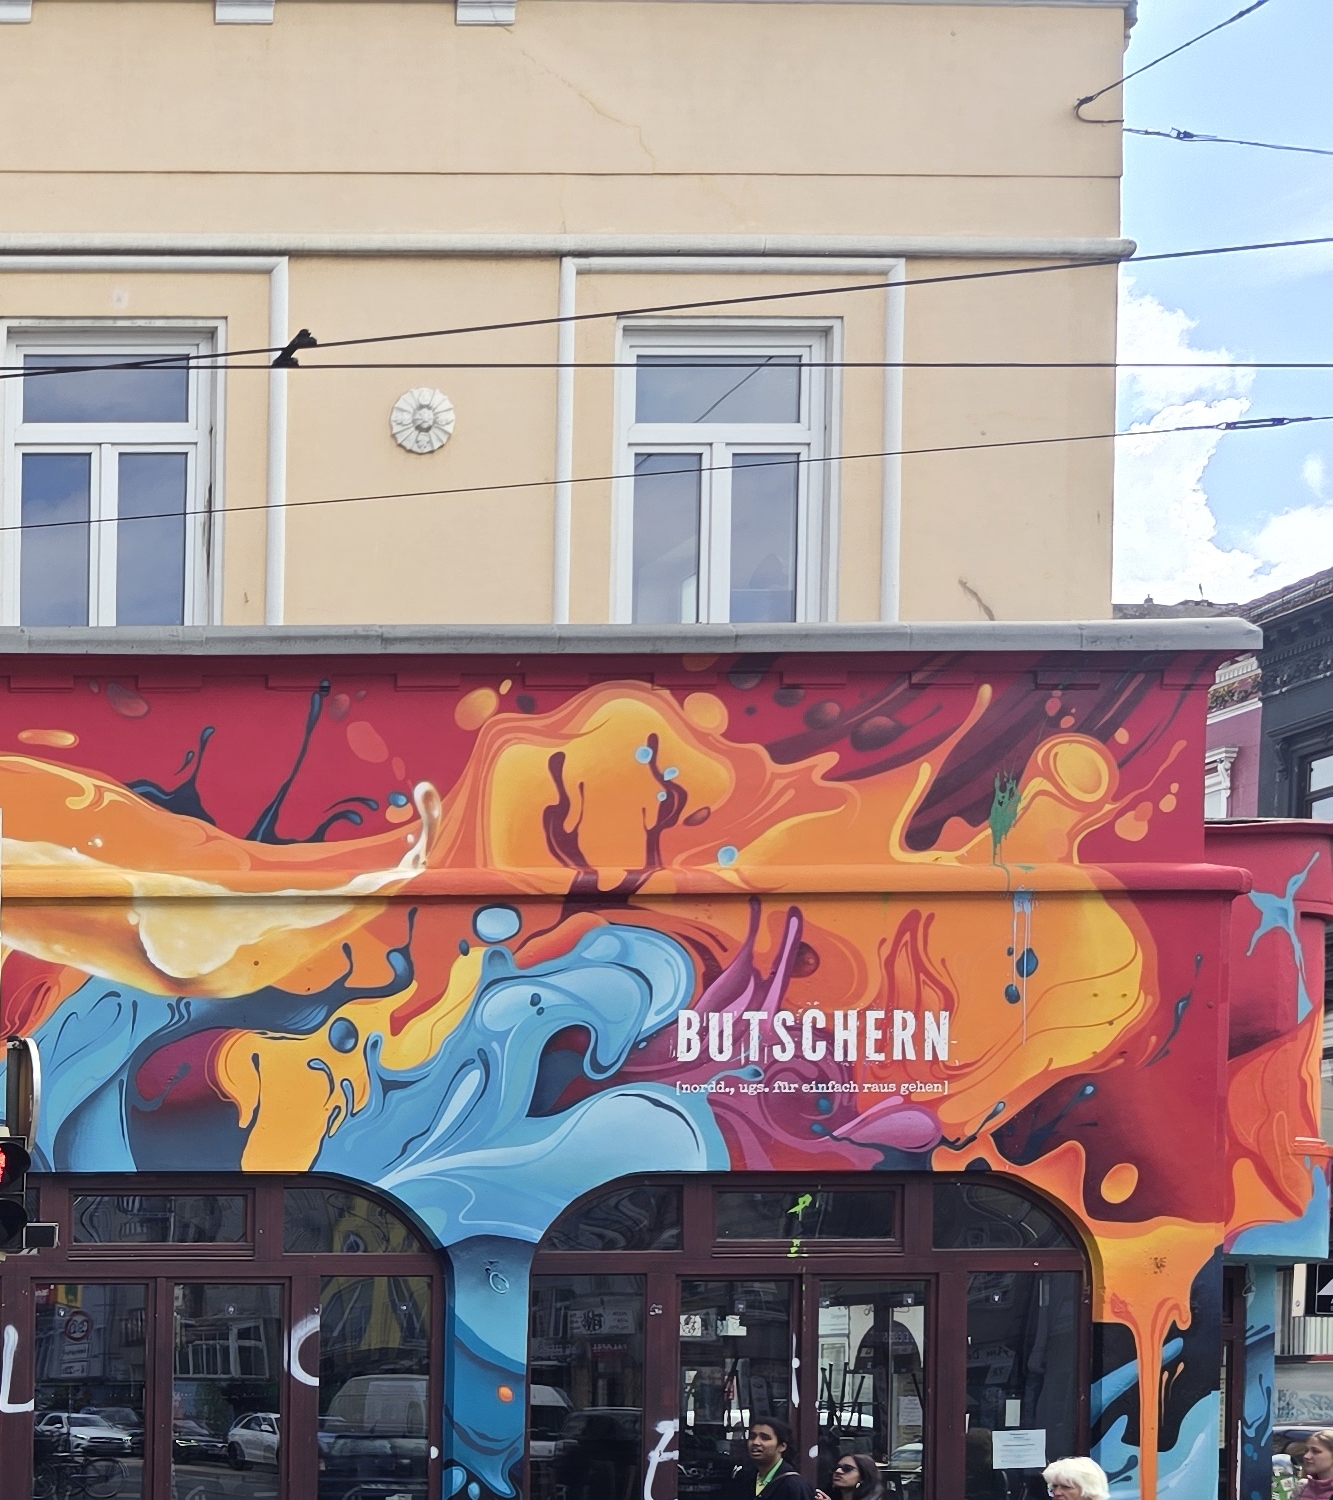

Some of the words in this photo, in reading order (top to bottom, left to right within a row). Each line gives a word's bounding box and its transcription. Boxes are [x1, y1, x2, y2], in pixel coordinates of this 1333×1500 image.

[676, 1009, 951, 1062] BUTSCHERN
[738, 1083, 770, 1096] ugs.
[773, 1080, 799, 1094] für
[801, 1080, 860, 1094] einfach
[862, 1083, 897, 1094] raus
